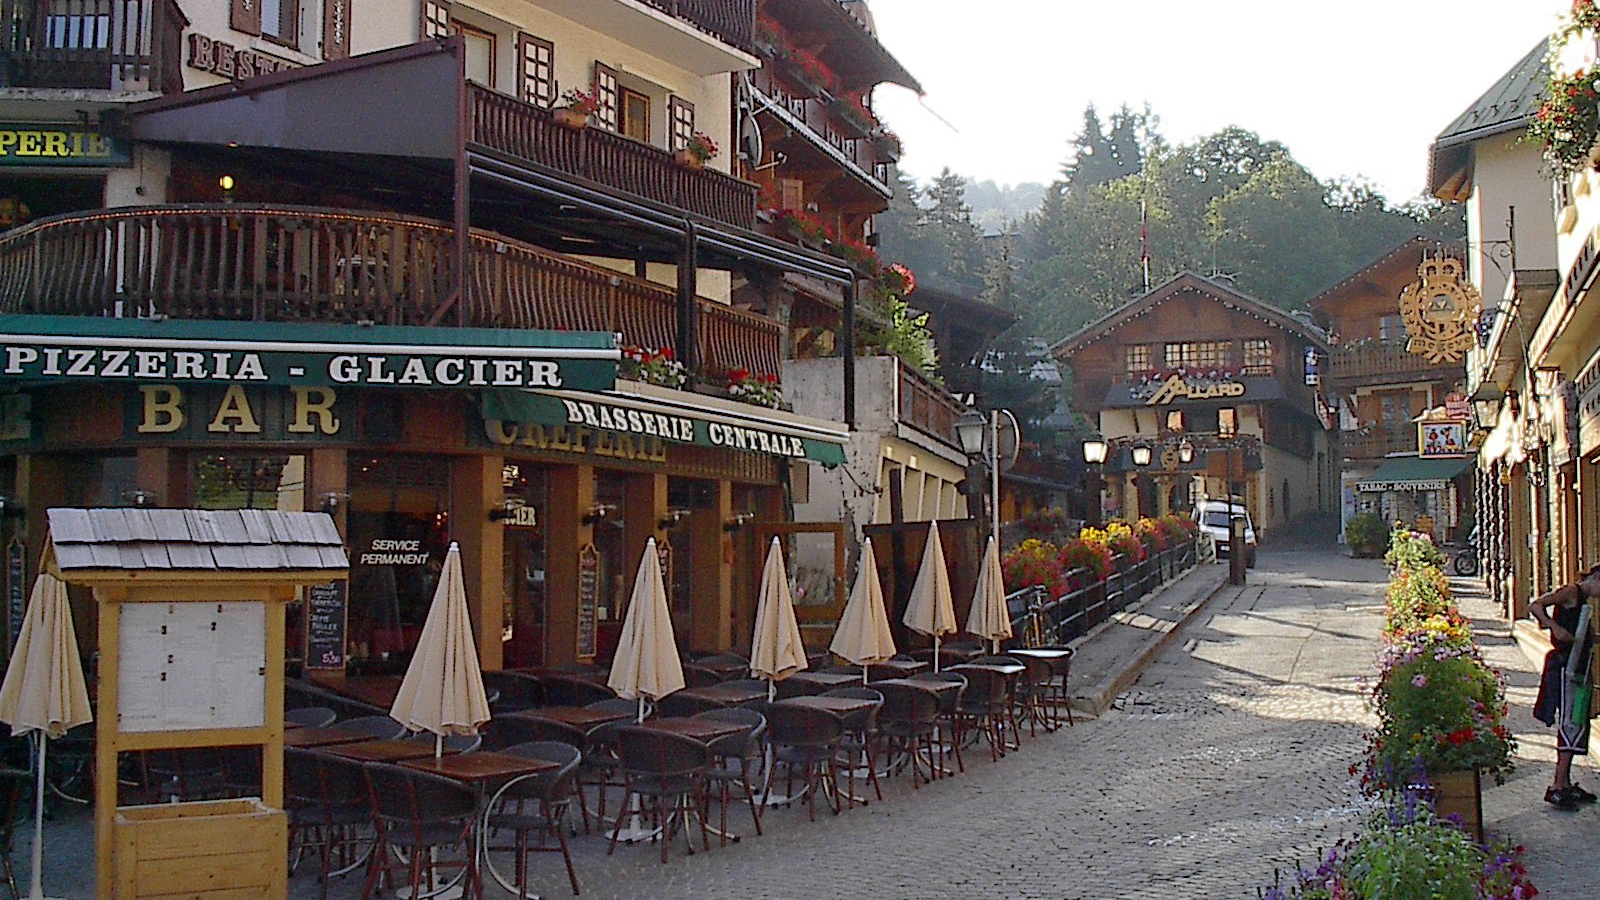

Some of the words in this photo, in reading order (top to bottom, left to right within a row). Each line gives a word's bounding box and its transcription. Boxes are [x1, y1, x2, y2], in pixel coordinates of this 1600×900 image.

[4, 347, 268, 381] PIZZERIA
[329, 356, 563, 387] GLACIER
[138, 385, 340, 434] BAR
[562, 400, 694, 441] BRASSERIE
[709, 424, 805, 457] CENTRALE
[360, 553, 428, 565] PERMANENT
[371, 539, 420, 551] SERVICE
